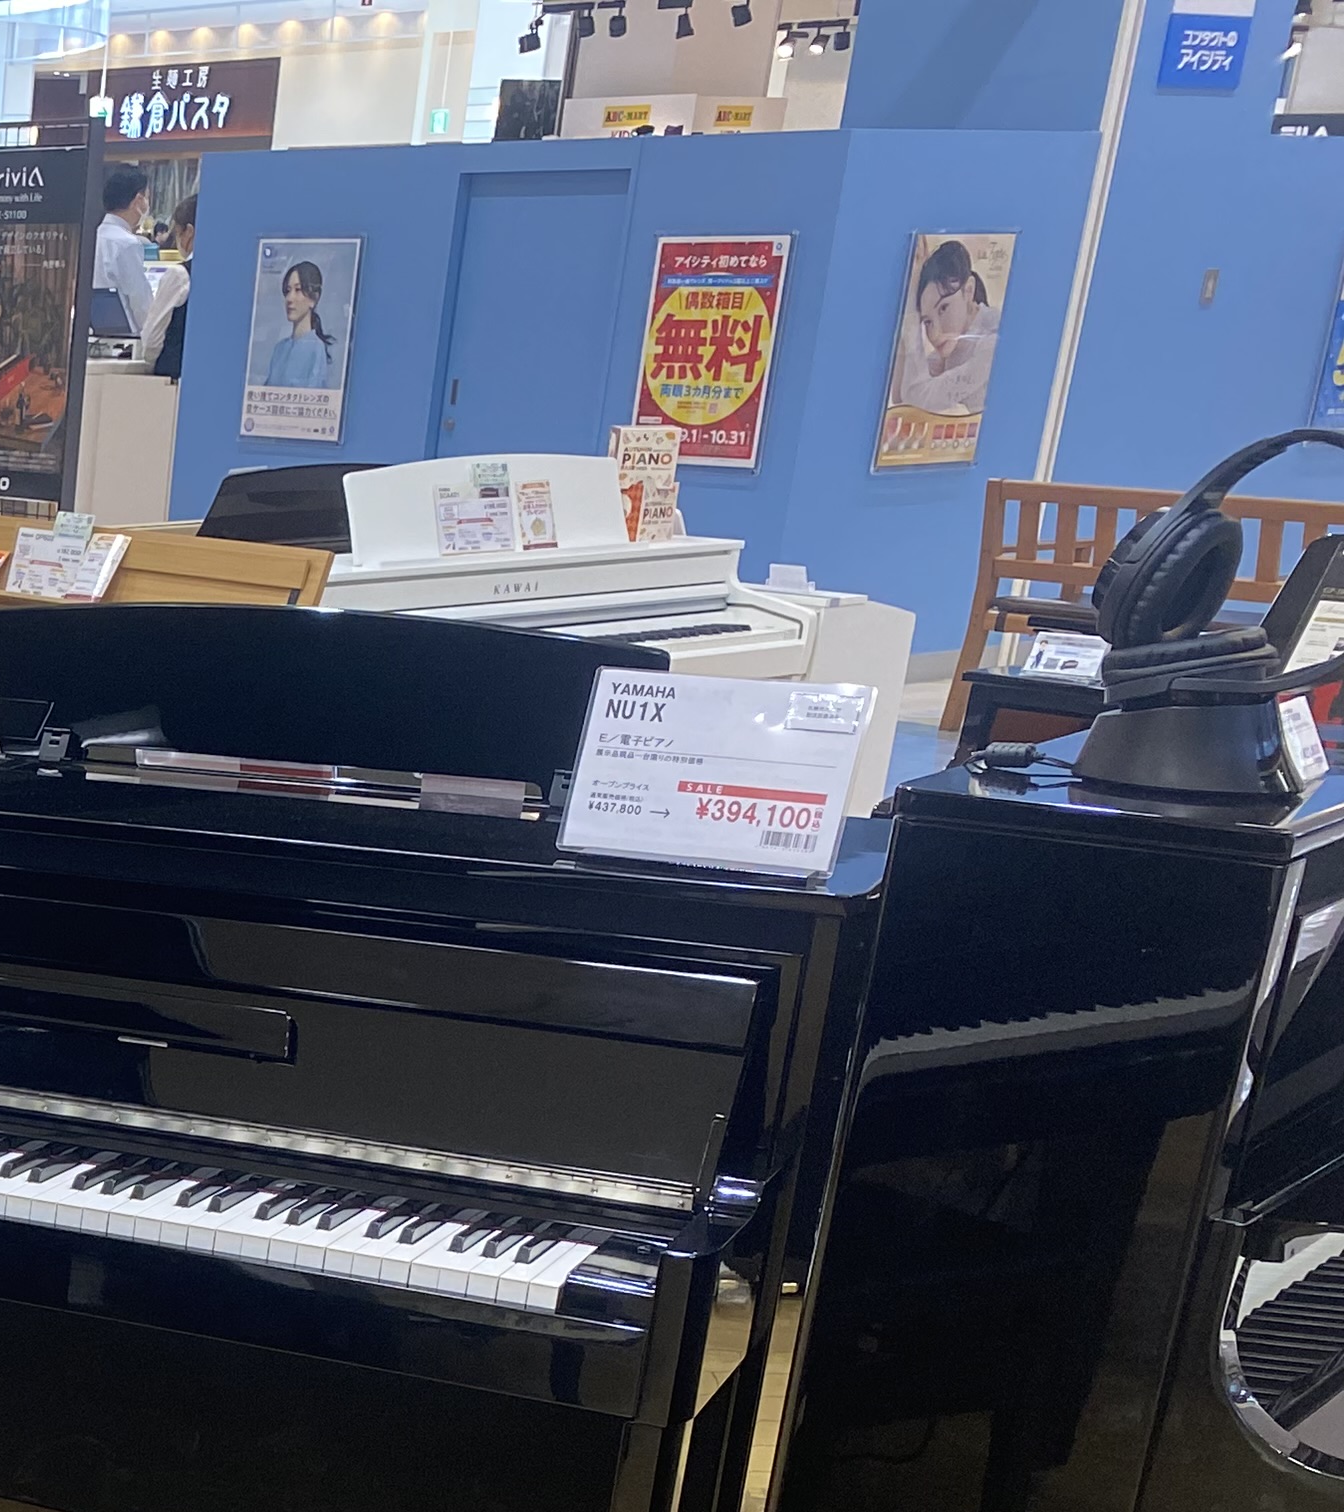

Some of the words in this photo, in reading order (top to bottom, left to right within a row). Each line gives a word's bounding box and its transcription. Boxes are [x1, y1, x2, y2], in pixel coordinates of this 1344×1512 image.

[1176, 49, 1234, 71] アイシティ
[119, 91, 231, 139] 鎌倉パスタ
[605, 110, 649, 123] ABC-MART
[715, 110, 753, 122] ABC-MART
[14, 193, 29, 203] with
[30, 192, 43, 203] Life
[674, 254, 768, 269] アイシティ初めてなら
[685, 291, 745, 311] 偶数箱目
[650, 313, 765, 383] 無料
[622, 453, 673, 465] PIANO
[643, 506, 673, 519] PIANO
[493, 581, 539, 595] KAWAI
[611, 682, 676, 700] YAMAHA
[605, 698, 666, 723] NU1X
[591, 779, 650, 792] オープンプライス
[685, 783, 724, 796] SALE
[587, 802, 642, 817] ¥437,800
[695, 797, 812, 831] ¥394,100
